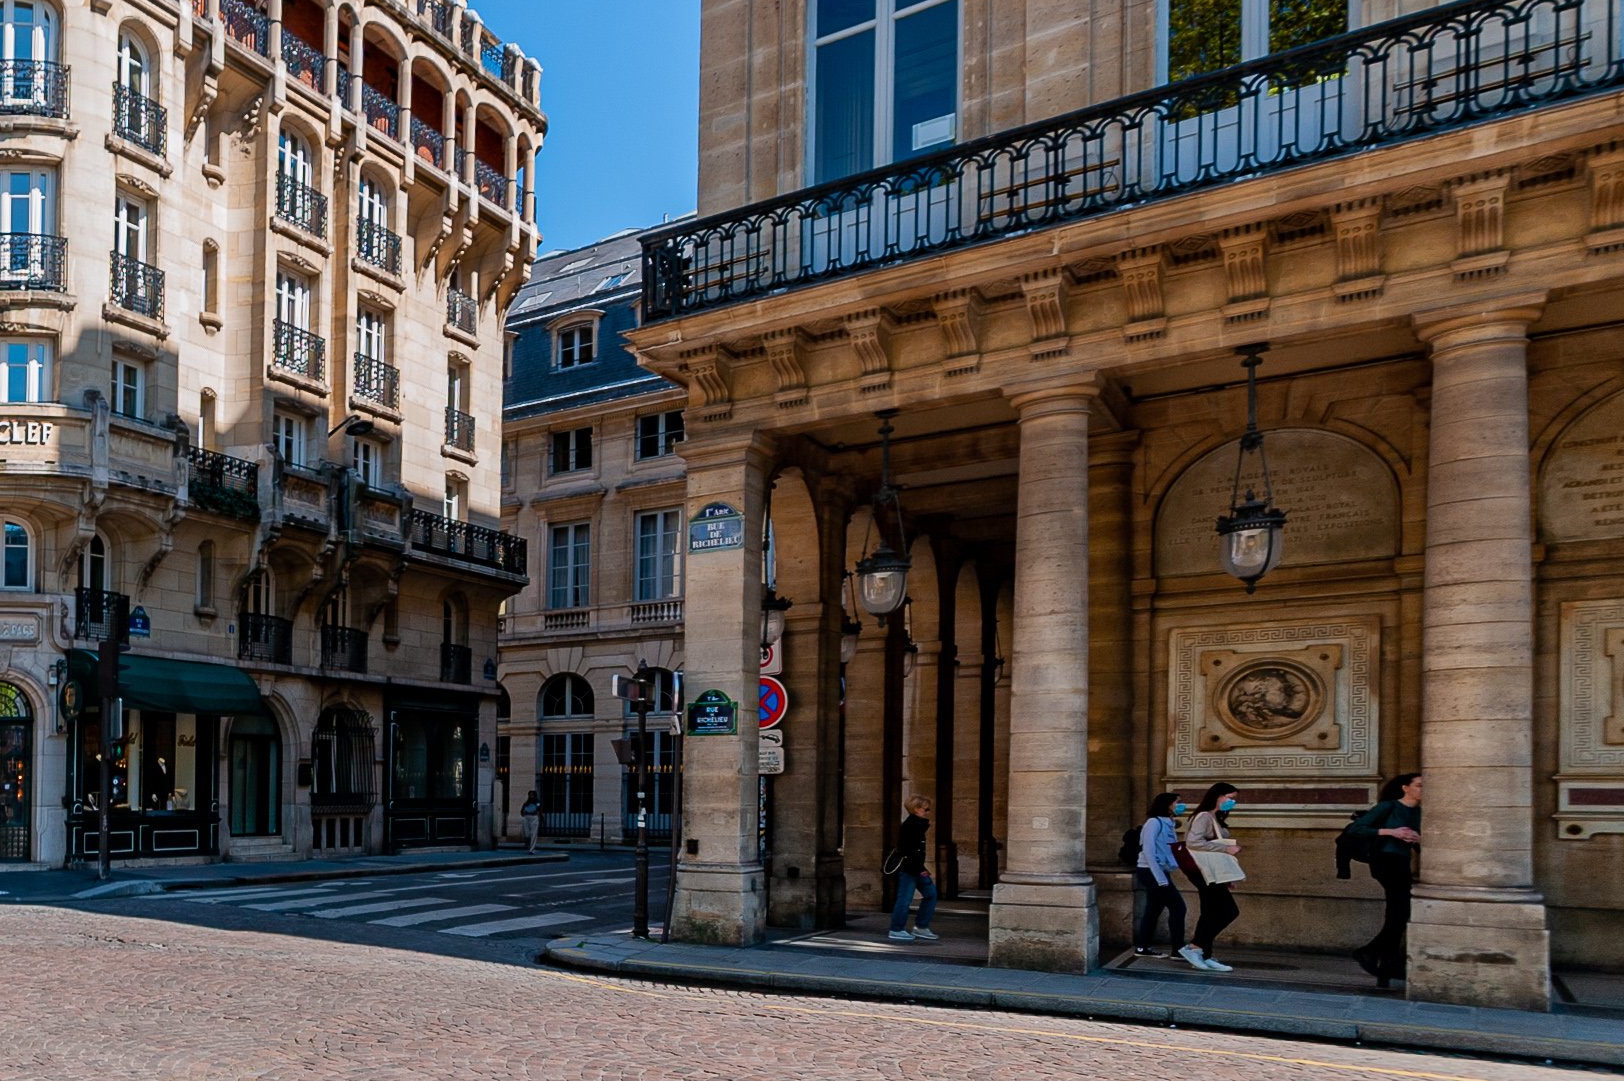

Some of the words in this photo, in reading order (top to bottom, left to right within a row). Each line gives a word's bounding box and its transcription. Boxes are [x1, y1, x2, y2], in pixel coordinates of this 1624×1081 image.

[707, 522, 725, 531] RUE
[710, 531, 722, 539] DE
[692, 536, 741, 549] RICHELIEU
